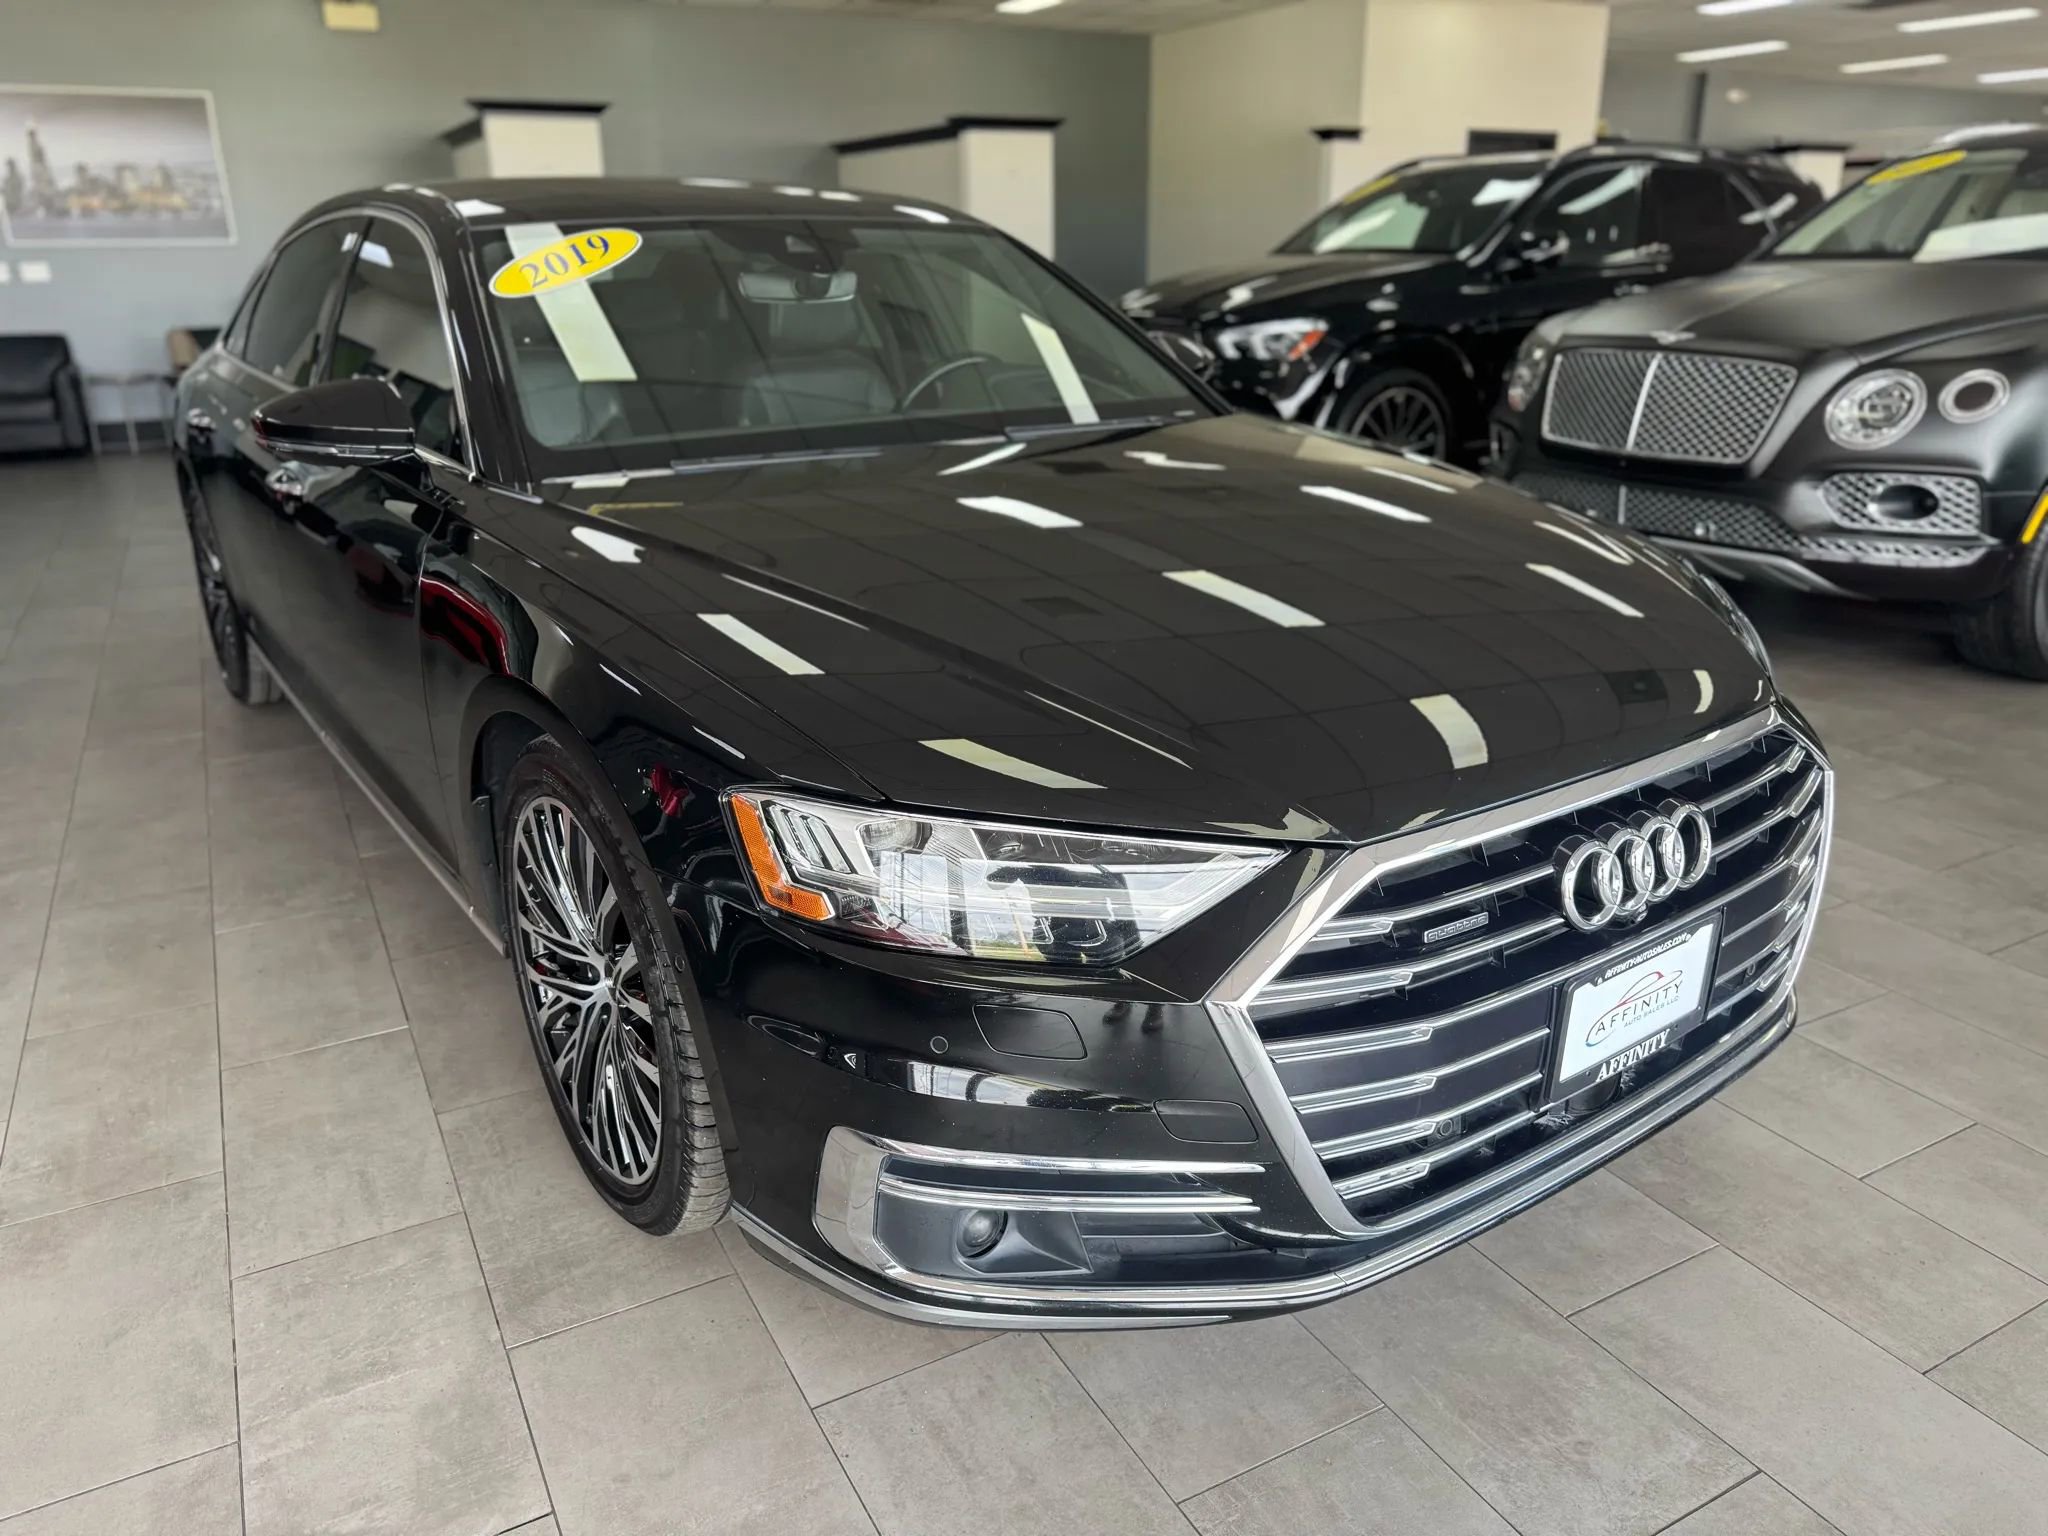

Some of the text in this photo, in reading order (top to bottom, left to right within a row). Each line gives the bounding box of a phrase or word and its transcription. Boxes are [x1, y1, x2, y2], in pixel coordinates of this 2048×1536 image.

[520, 235, 609, 287] 2019
[1428, 915, 1487, 941] quattro
[1596, 981, 1683, 1035] AFFINITY
[1624, 1014, 1642, 1027] AUTO
[1595, 1029, 1671, 1083] AFFINITY
